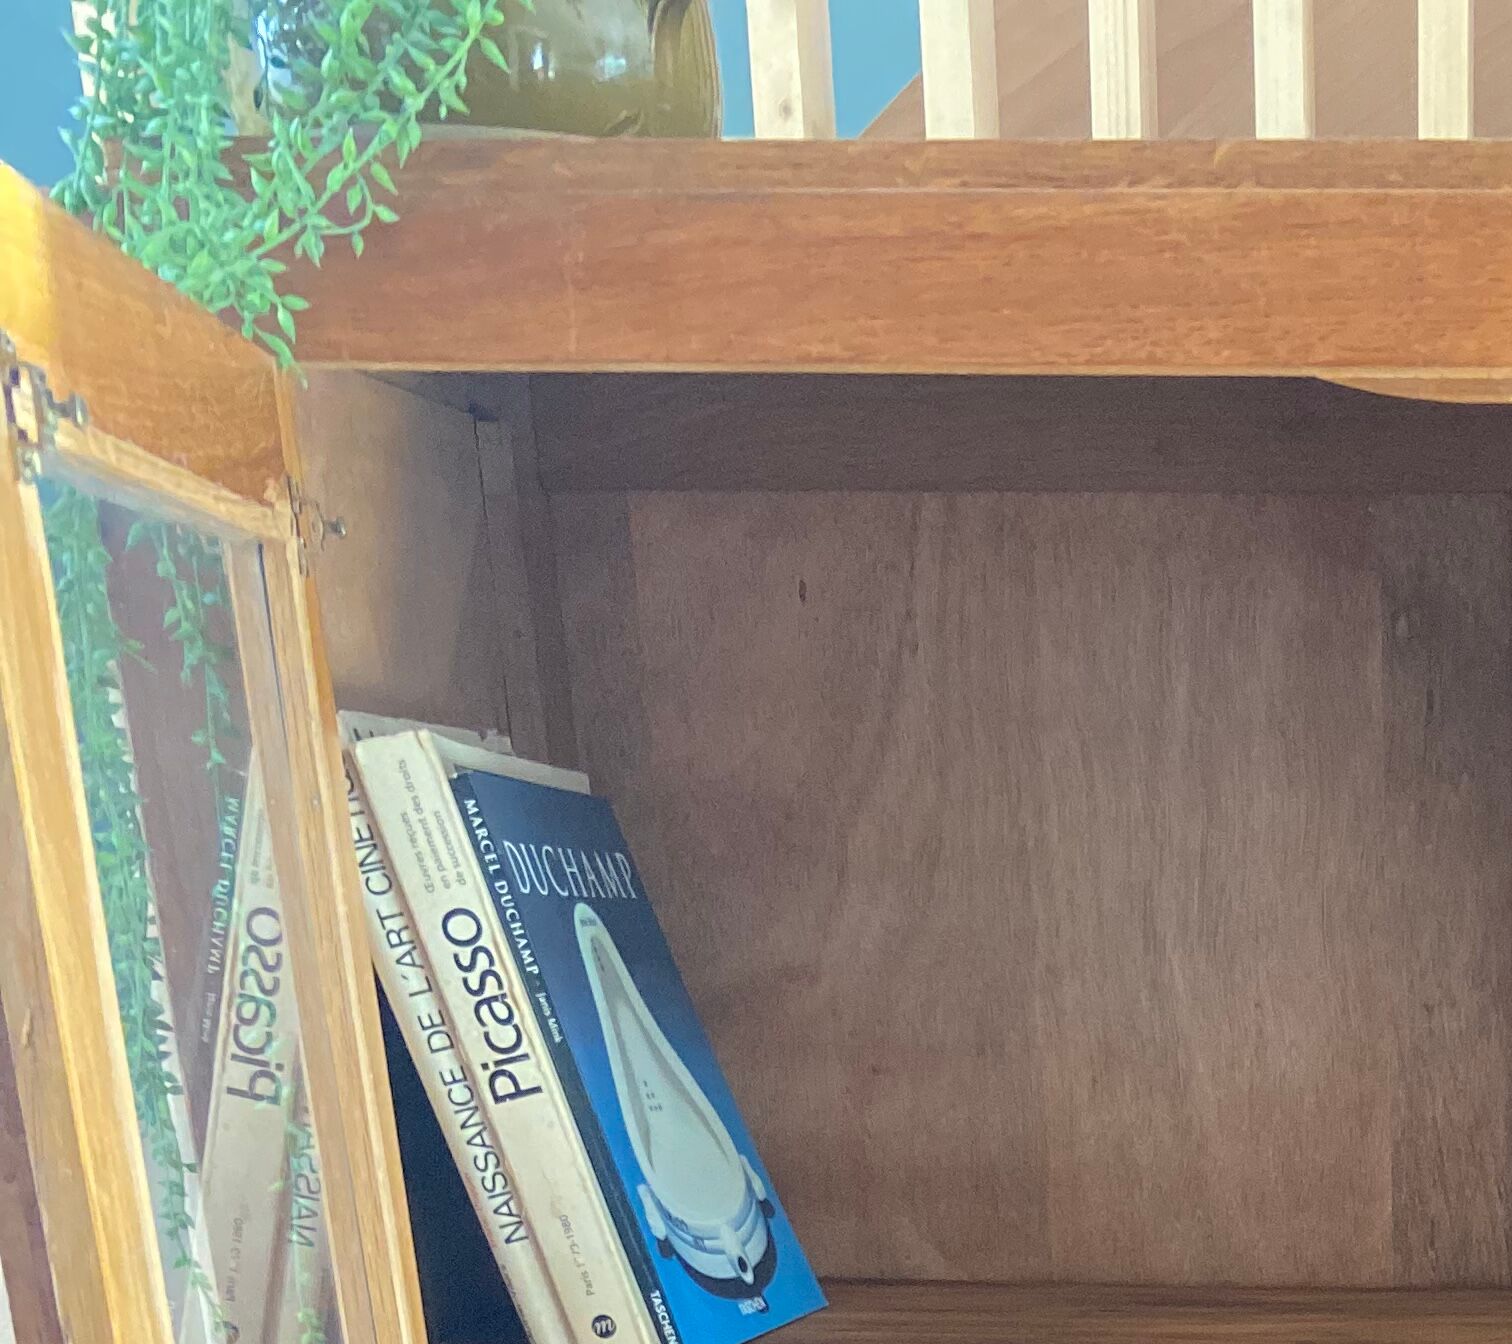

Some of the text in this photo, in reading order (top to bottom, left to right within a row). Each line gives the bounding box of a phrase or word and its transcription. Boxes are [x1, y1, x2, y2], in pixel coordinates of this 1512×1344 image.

[399, 759, 451, 890] en paiement des droits
[433, 810, 467, 886] de succession
[502, 839, 638, 900] DUCHAMP
[464, 799, 501, 875] MARCEL
[494, 880, 540, 976] DUCHAMP
[417, 1008, 455, 1054] DE
[441, 907, 544, 1105] Picasso
[439, 1064, 530, 1245] NAISSANCE
[580, 1270, 595, 1297] Paris
